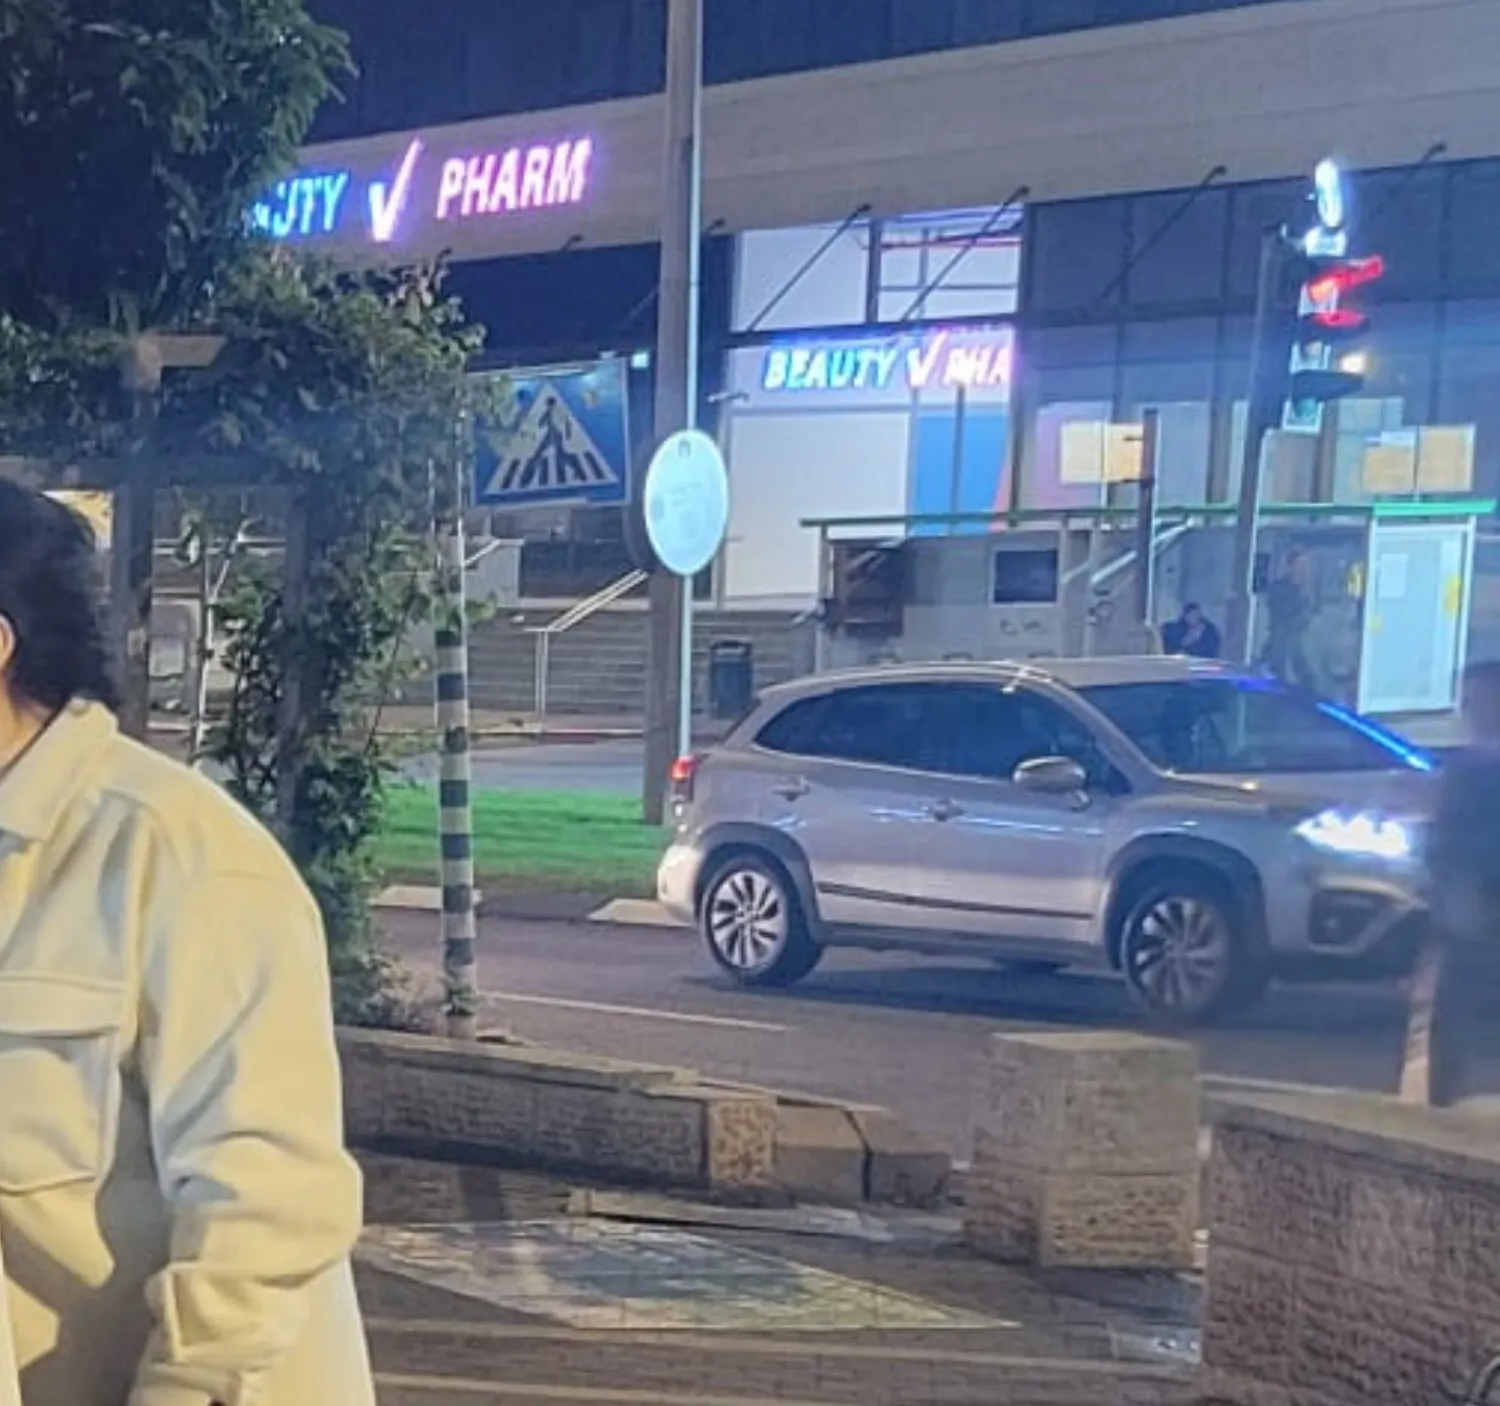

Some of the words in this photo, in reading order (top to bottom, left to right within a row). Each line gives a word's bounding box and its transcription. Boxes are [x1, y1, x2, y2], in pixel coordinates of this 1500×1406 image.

[436, 137, 592, 219] PHARM
[764, 346, 898, 388] BEAUTY
[943, 346, 1012, 386] PHA
